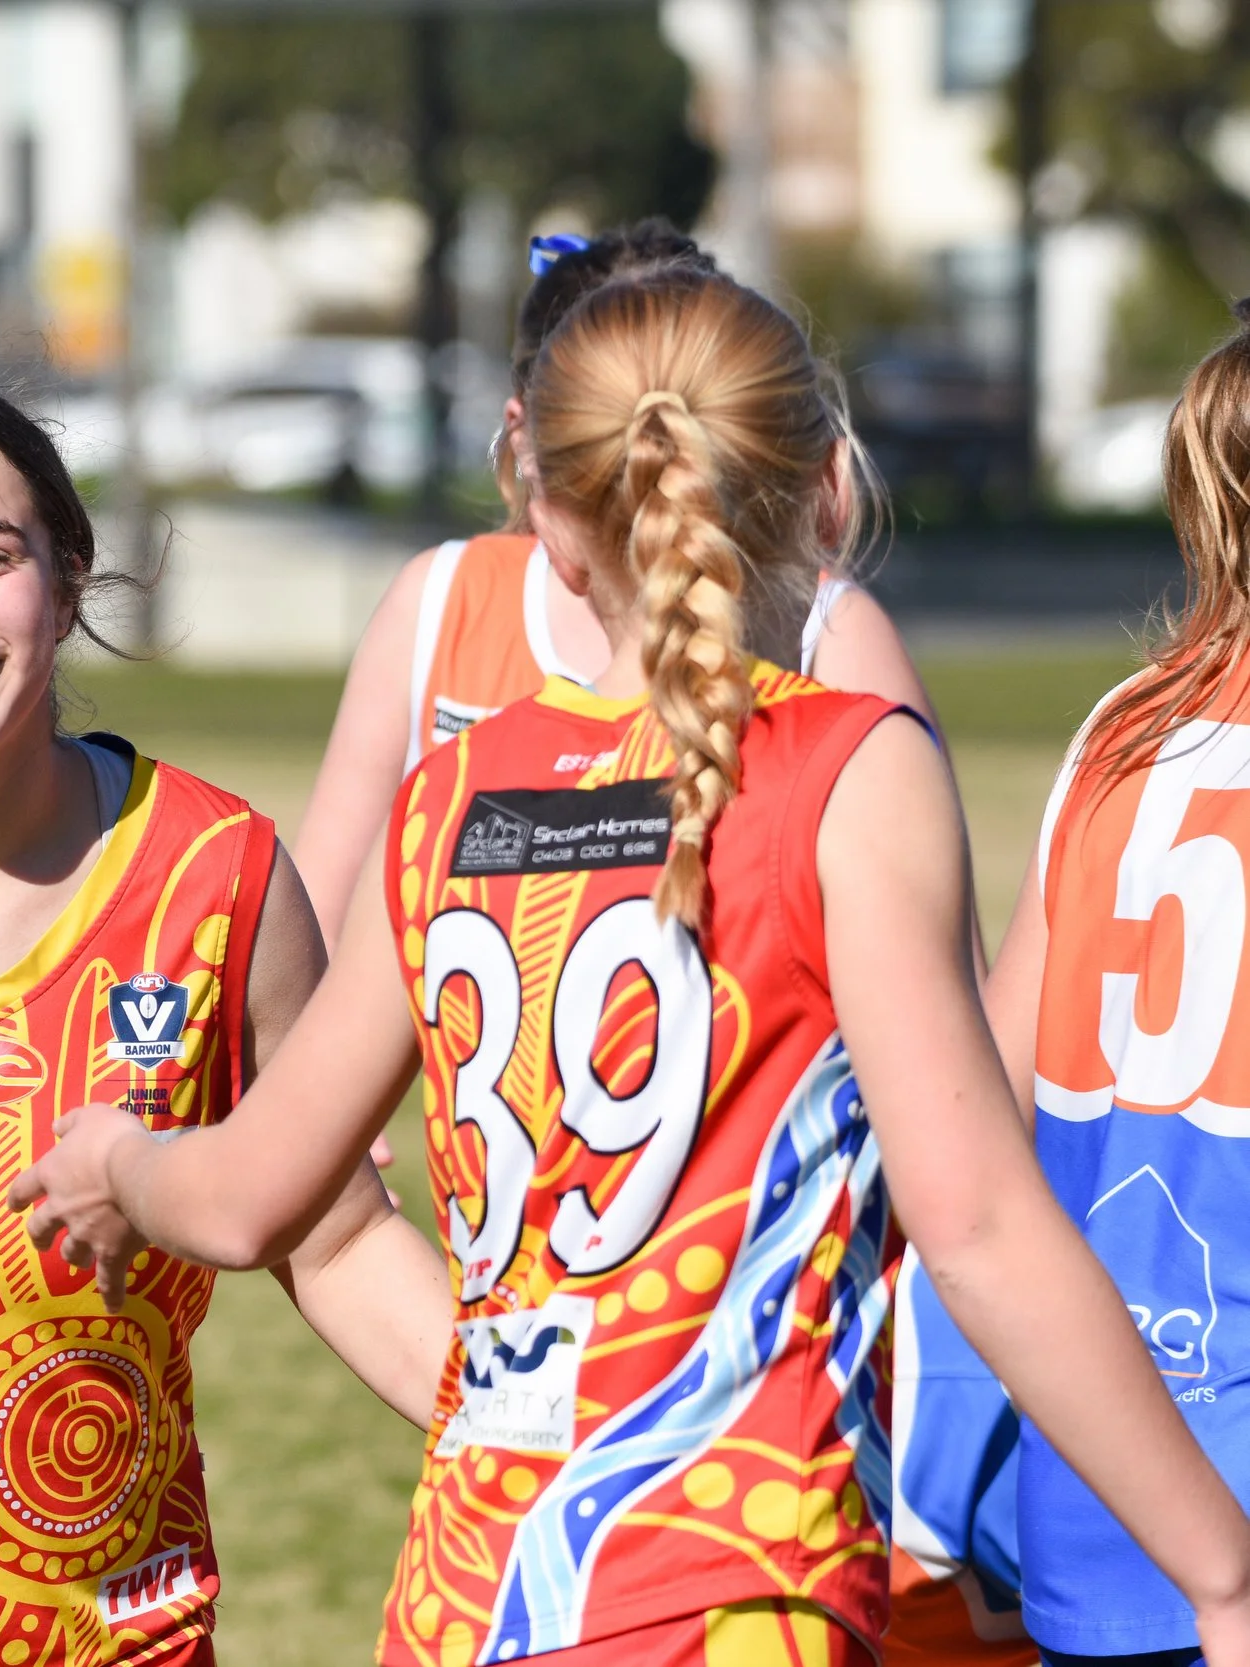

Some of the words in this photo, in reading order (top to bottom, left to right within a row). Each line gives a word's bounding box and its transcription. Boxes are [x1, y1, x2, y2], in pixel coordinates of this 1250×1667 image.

[597, 817, 669, 837] Homes
[133, 976, 165, 990] AFL
[121, 1001, 176, 1042] V
[125, 1044, 171, 1056] BARWON
[128, 1088, 167, 1103] JUNIOR
[424, 896, 712, 1304] 39
[105, 1553, 185, 1616] TWP
